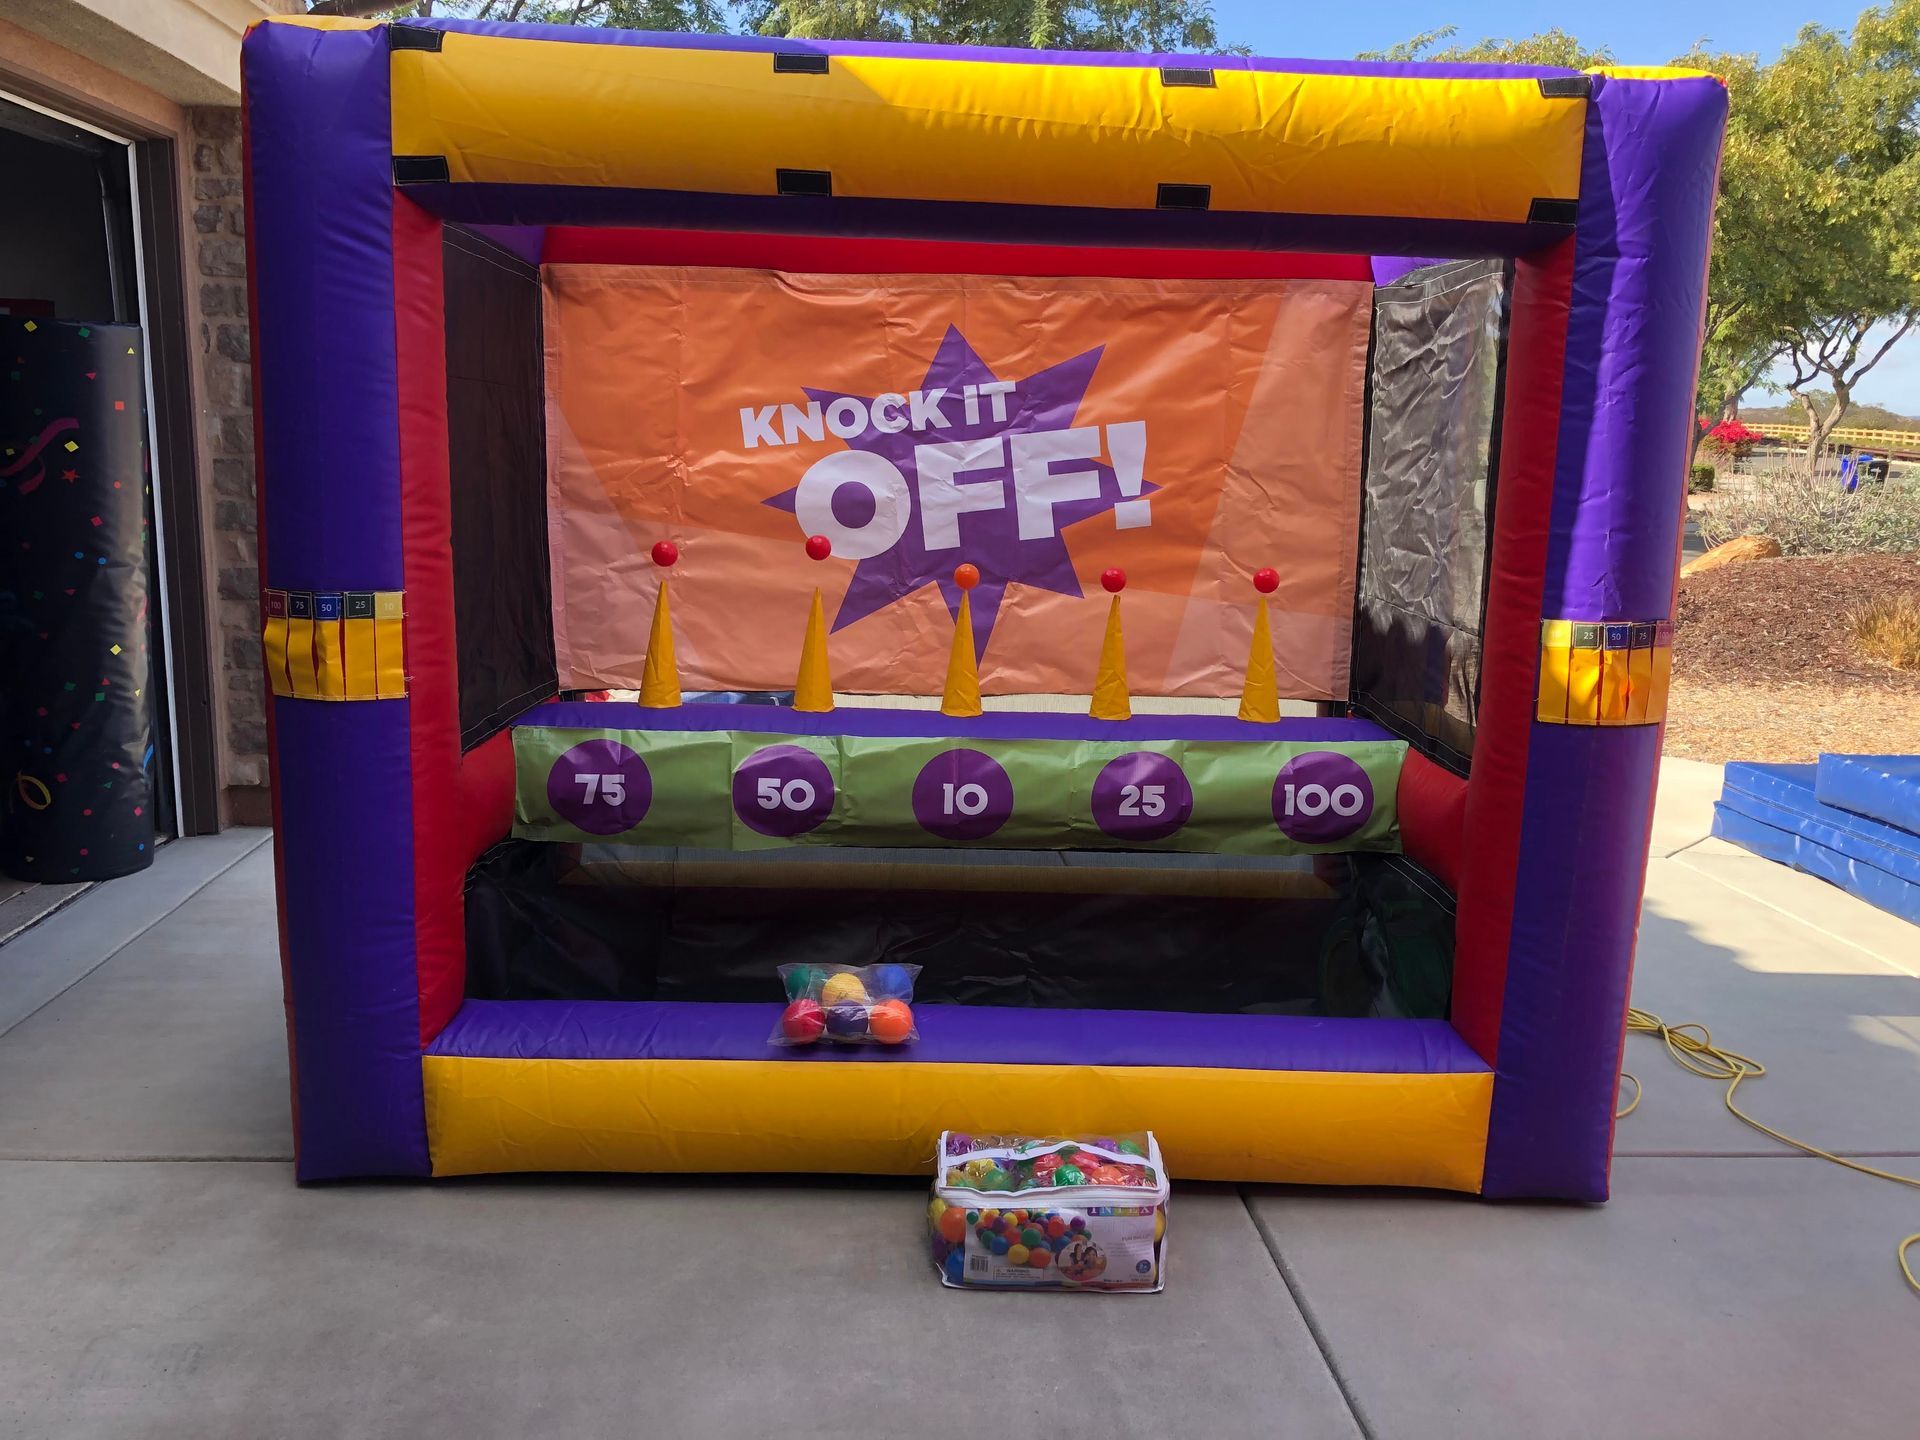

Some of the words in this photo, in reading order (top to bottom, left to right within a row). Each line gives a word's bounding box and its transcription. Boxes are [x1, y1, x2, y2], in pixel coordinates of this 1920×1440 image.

[739, 387, 952, 448] KNOCK
[964, 380, 1016, 425] IT
[795, 420, 1152, 560] OFF!
[271, 601, 282, 609] 100
[295, 601, 305, 609] 75
[321, 603, 332, 612] 50
[355, 601, 366, 609] 25
[384, 602, 394, 611] 10
[1583, 631, 1594, 640] 25
[1611, 633, 1622, 641] 50
[1639, 632, 1647, 640] 75
[574, 773, 626, 807] 75
[757, 777, 816, 811] 50
[942, 783, 989, 816] 10
[1118, 784, 1166, 817] 25
[1284, 783, 1364, 817] 100
